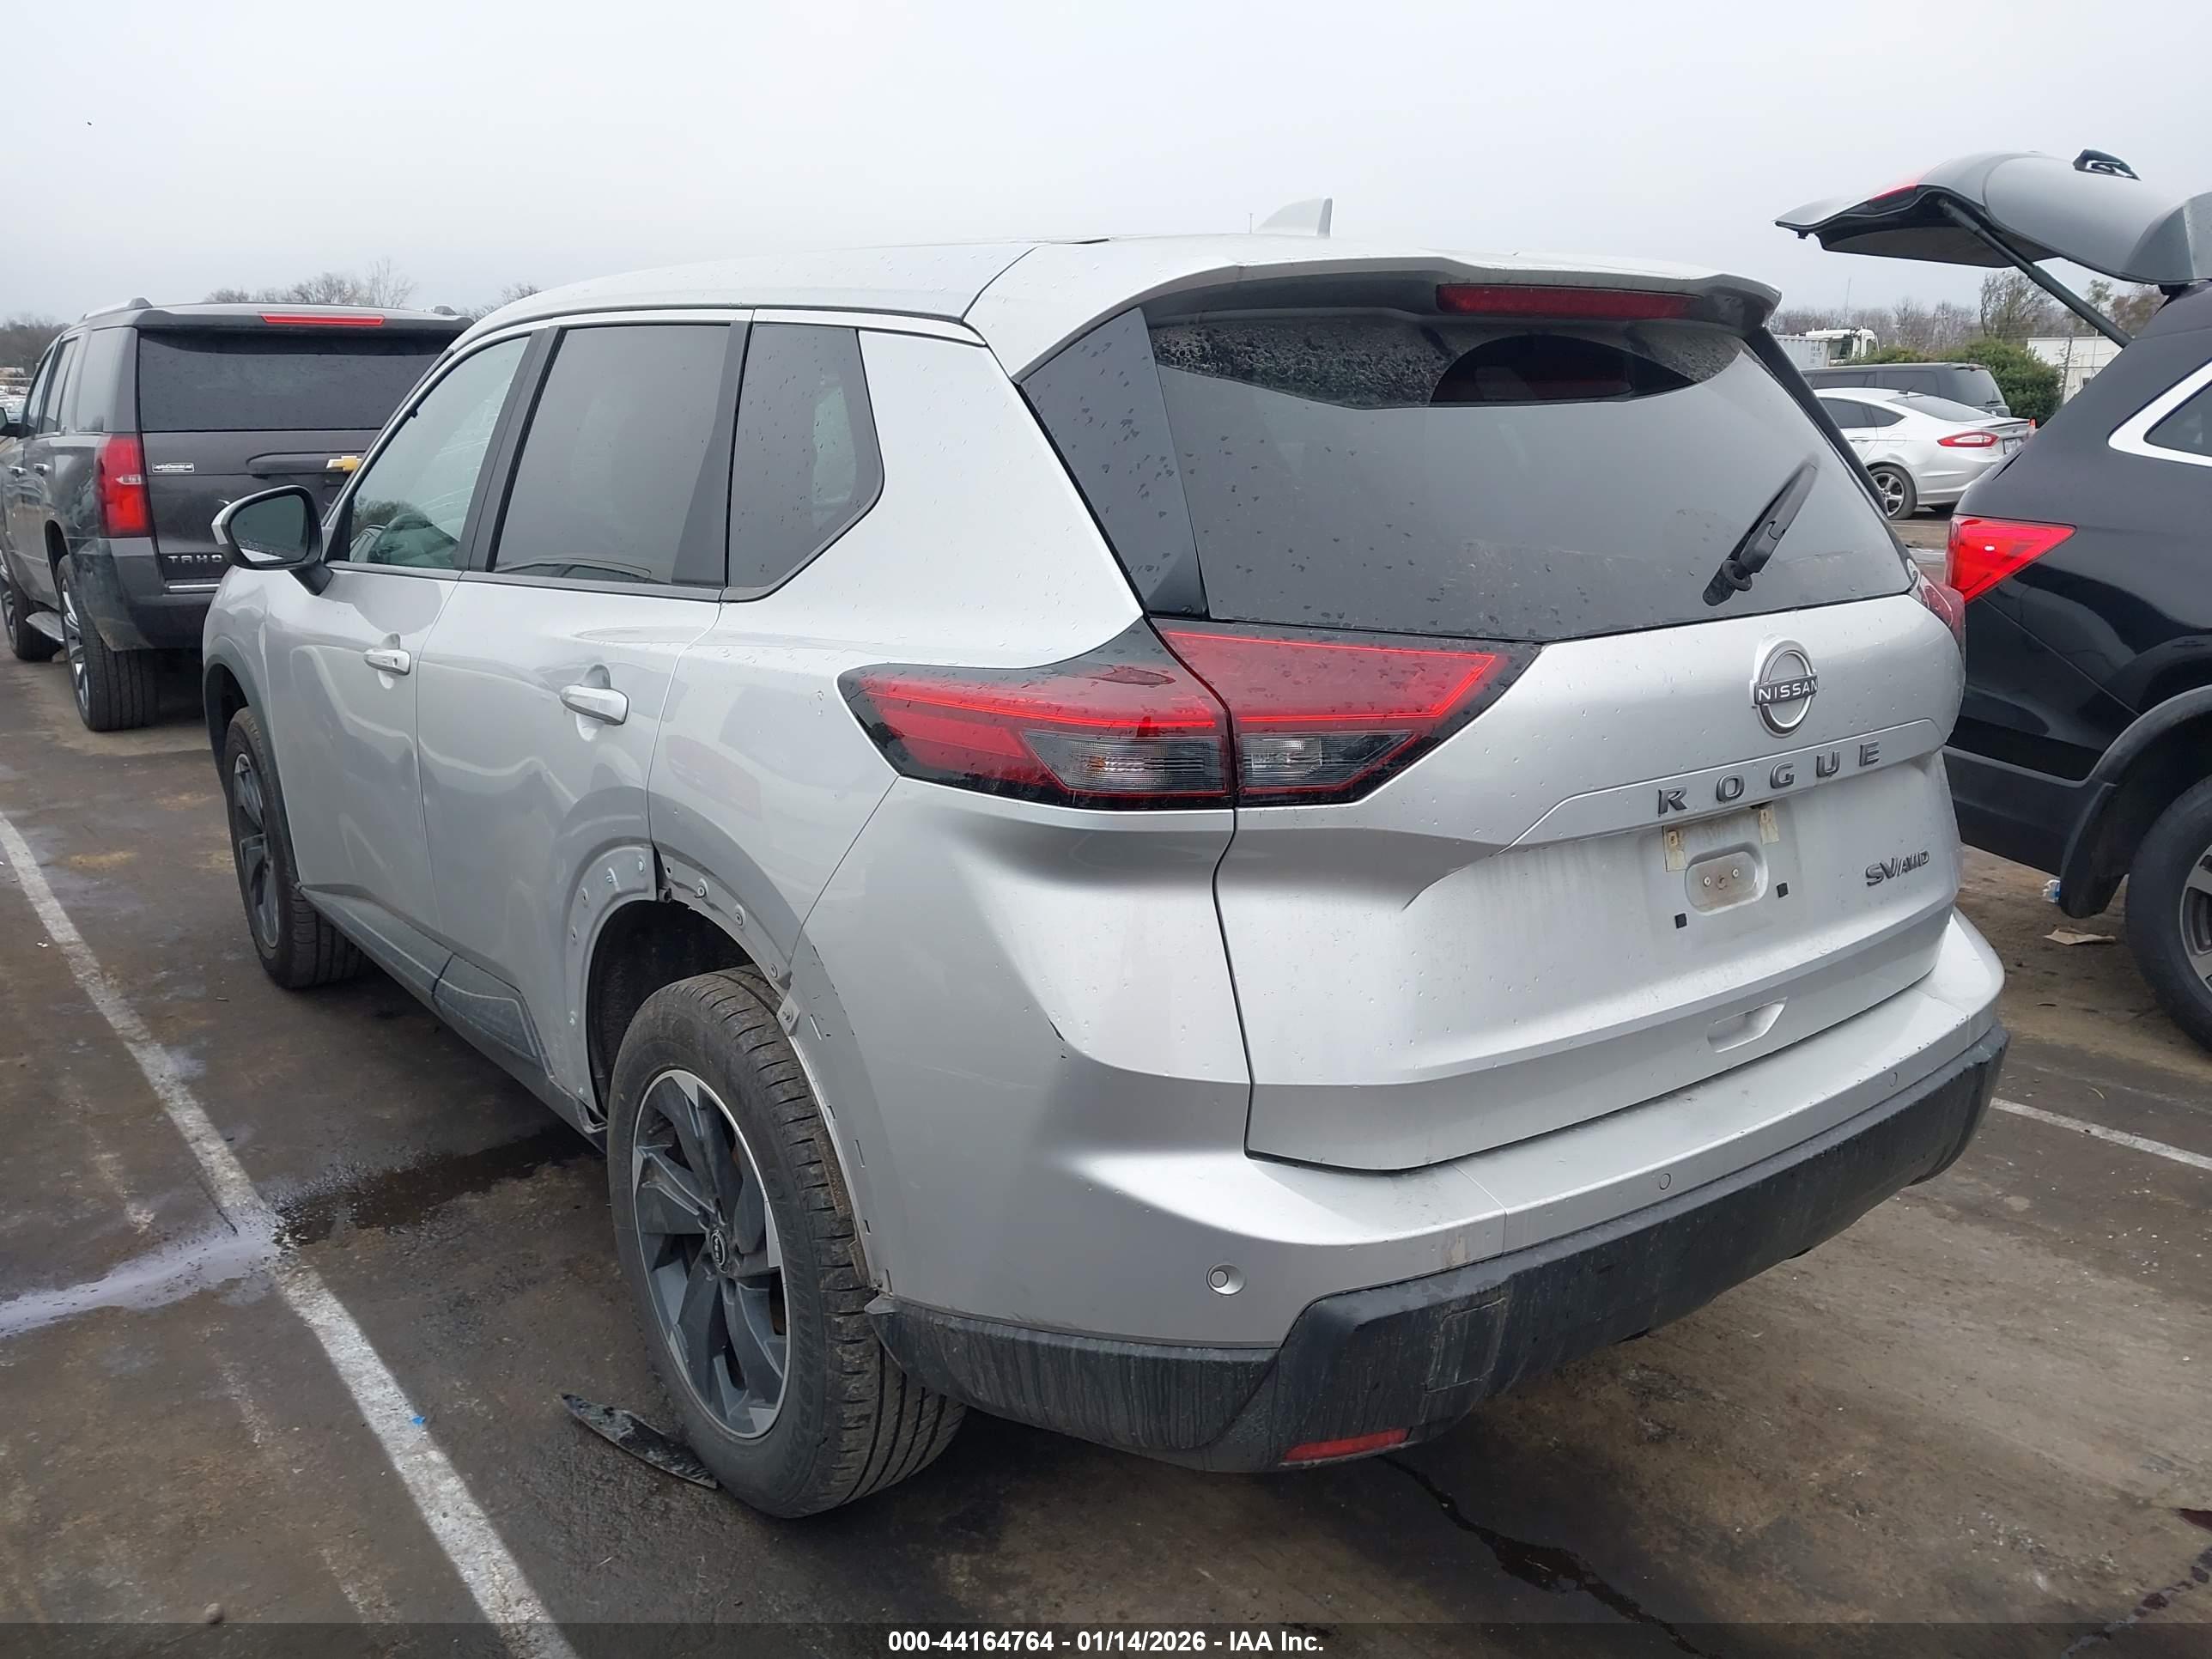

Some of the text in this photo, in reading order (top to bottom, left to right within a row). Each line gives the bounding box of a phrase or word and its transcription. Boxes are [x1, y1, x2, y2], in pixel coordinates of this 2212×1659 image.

[167, 554, 223, 564] TAHO
[1758, 679, 1818, 702] NISSAN
[1657, 740, 1881, 817] ROGUE
